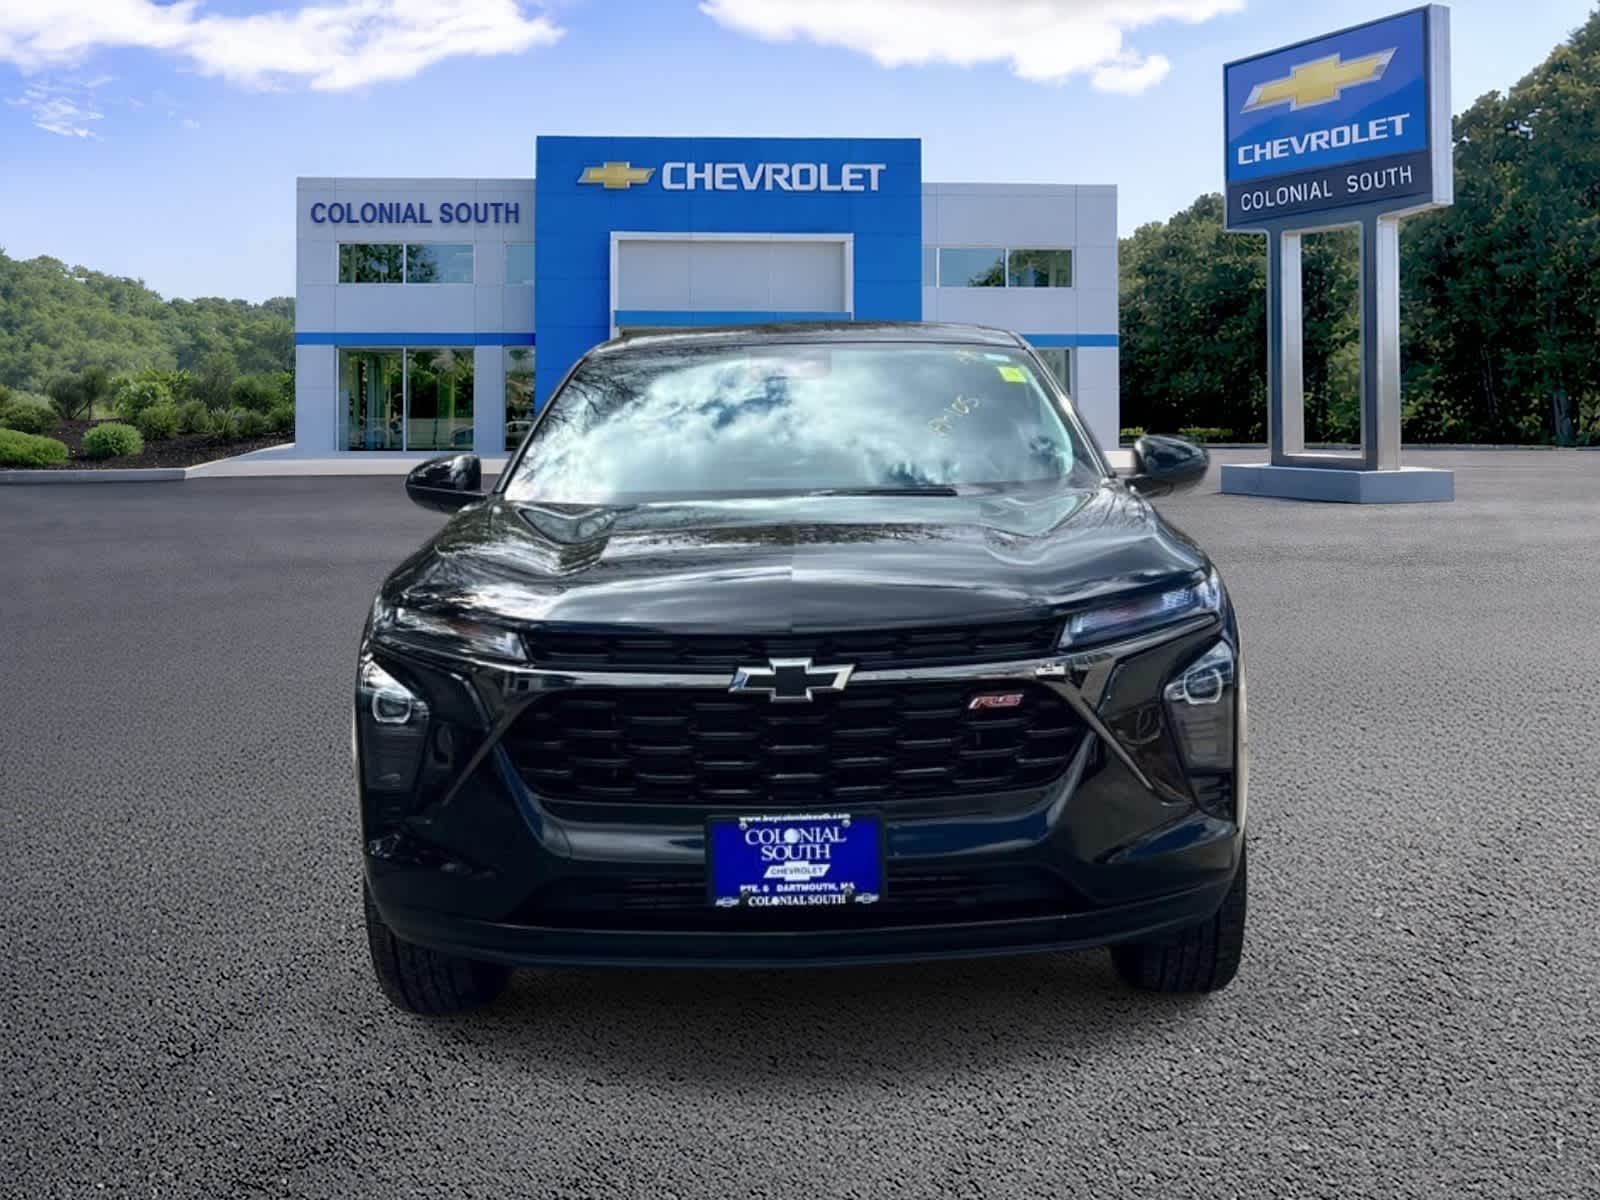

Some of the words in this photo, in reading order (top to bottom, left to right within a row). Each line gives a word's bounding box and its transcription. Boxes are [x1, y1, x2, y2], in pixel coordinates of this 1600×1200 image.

[1238, 113, 1410, 165] CHEVROLET
[662, 162, 887, 192] CHEVROLET
[1241, 179, 1333, 211] COLONIAL
[1346, 165, 1412, 193] SOUTH
[310, 202, 432, 225] COLONIAL
[440, 202, 520, 225] SOUTH
[968, 694, 1024, 710] RS
[745, 827, 847, 845] COLONIAL
[761, 844, 831, 861] SOUTH
[770, 866, 823, 875] CHEVROLET
[748, 895, 806, 906] COLONIAL
[807, 894, 846, 905] SOUTH
